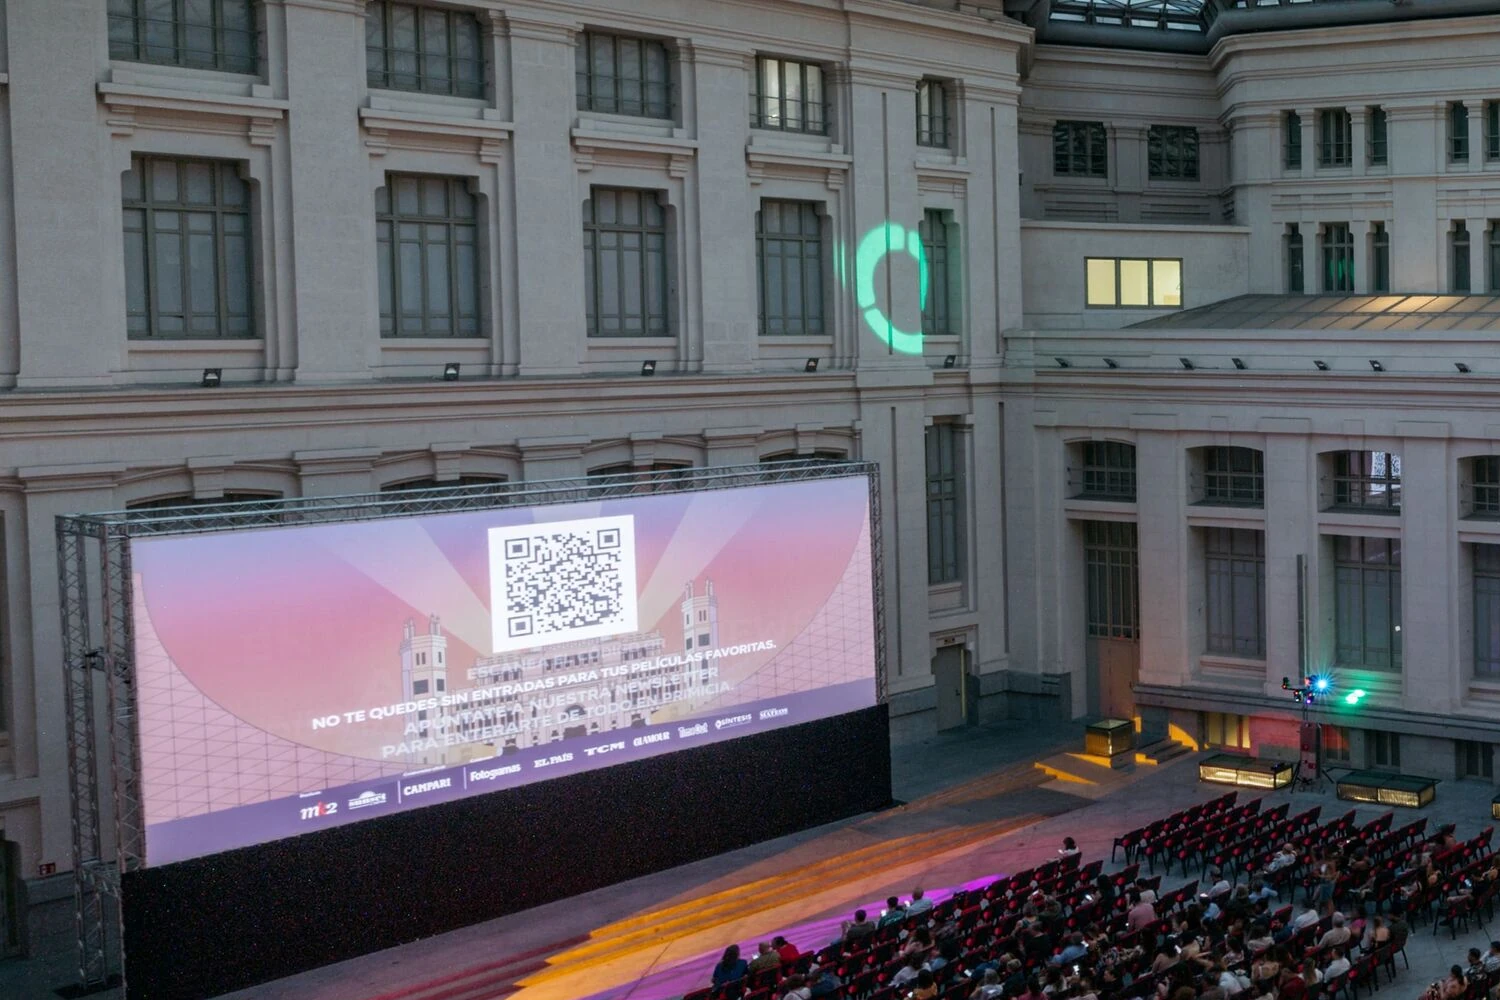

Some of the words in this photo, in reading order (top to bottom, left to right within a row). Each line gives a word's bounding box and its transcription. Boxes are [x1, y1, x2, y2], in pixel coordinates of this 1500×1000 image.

[312, 715, 341, 730] NO
[344, 710, 366, 724] TE
[369, 697, 438, 720] QUEDES
[438, 692, 469, 707] SIN
[472, 677, 555, 701] ENTRADAS
[558, 670, 598, 687] PARA
[600, 664, 629, 678] TUS
[631, 651, 703, 673] PELÍCULAS
[705, 640, 776, 660] FAVORITAS.
[404, 705, 506, 736] APÚNTATE
[512, 702, 525, 716] A
[529, 687, 612, 710] NUESTRA
[616, 667, 718, 696] NEWSLETTER
[383, 738, 438, 759] PARA
[444, 715, 552, 746] ENTERARTE
[559, 708, 580, 724] DE
[585, 699, 633, 717] TODO
[637, 693, 657, 707] EN
[663, 681, 735, 703] PRIMICIA.
[633, 731, 670, 747] GLAMOUR
[584, 741, 625, 756] TCM
[533, 759, 550, 769] EL
[550, 752, 574, 766] PAÍS
[403, 778, 451, 796] CAMPARI
[300, 801, 338, 820] mk2
